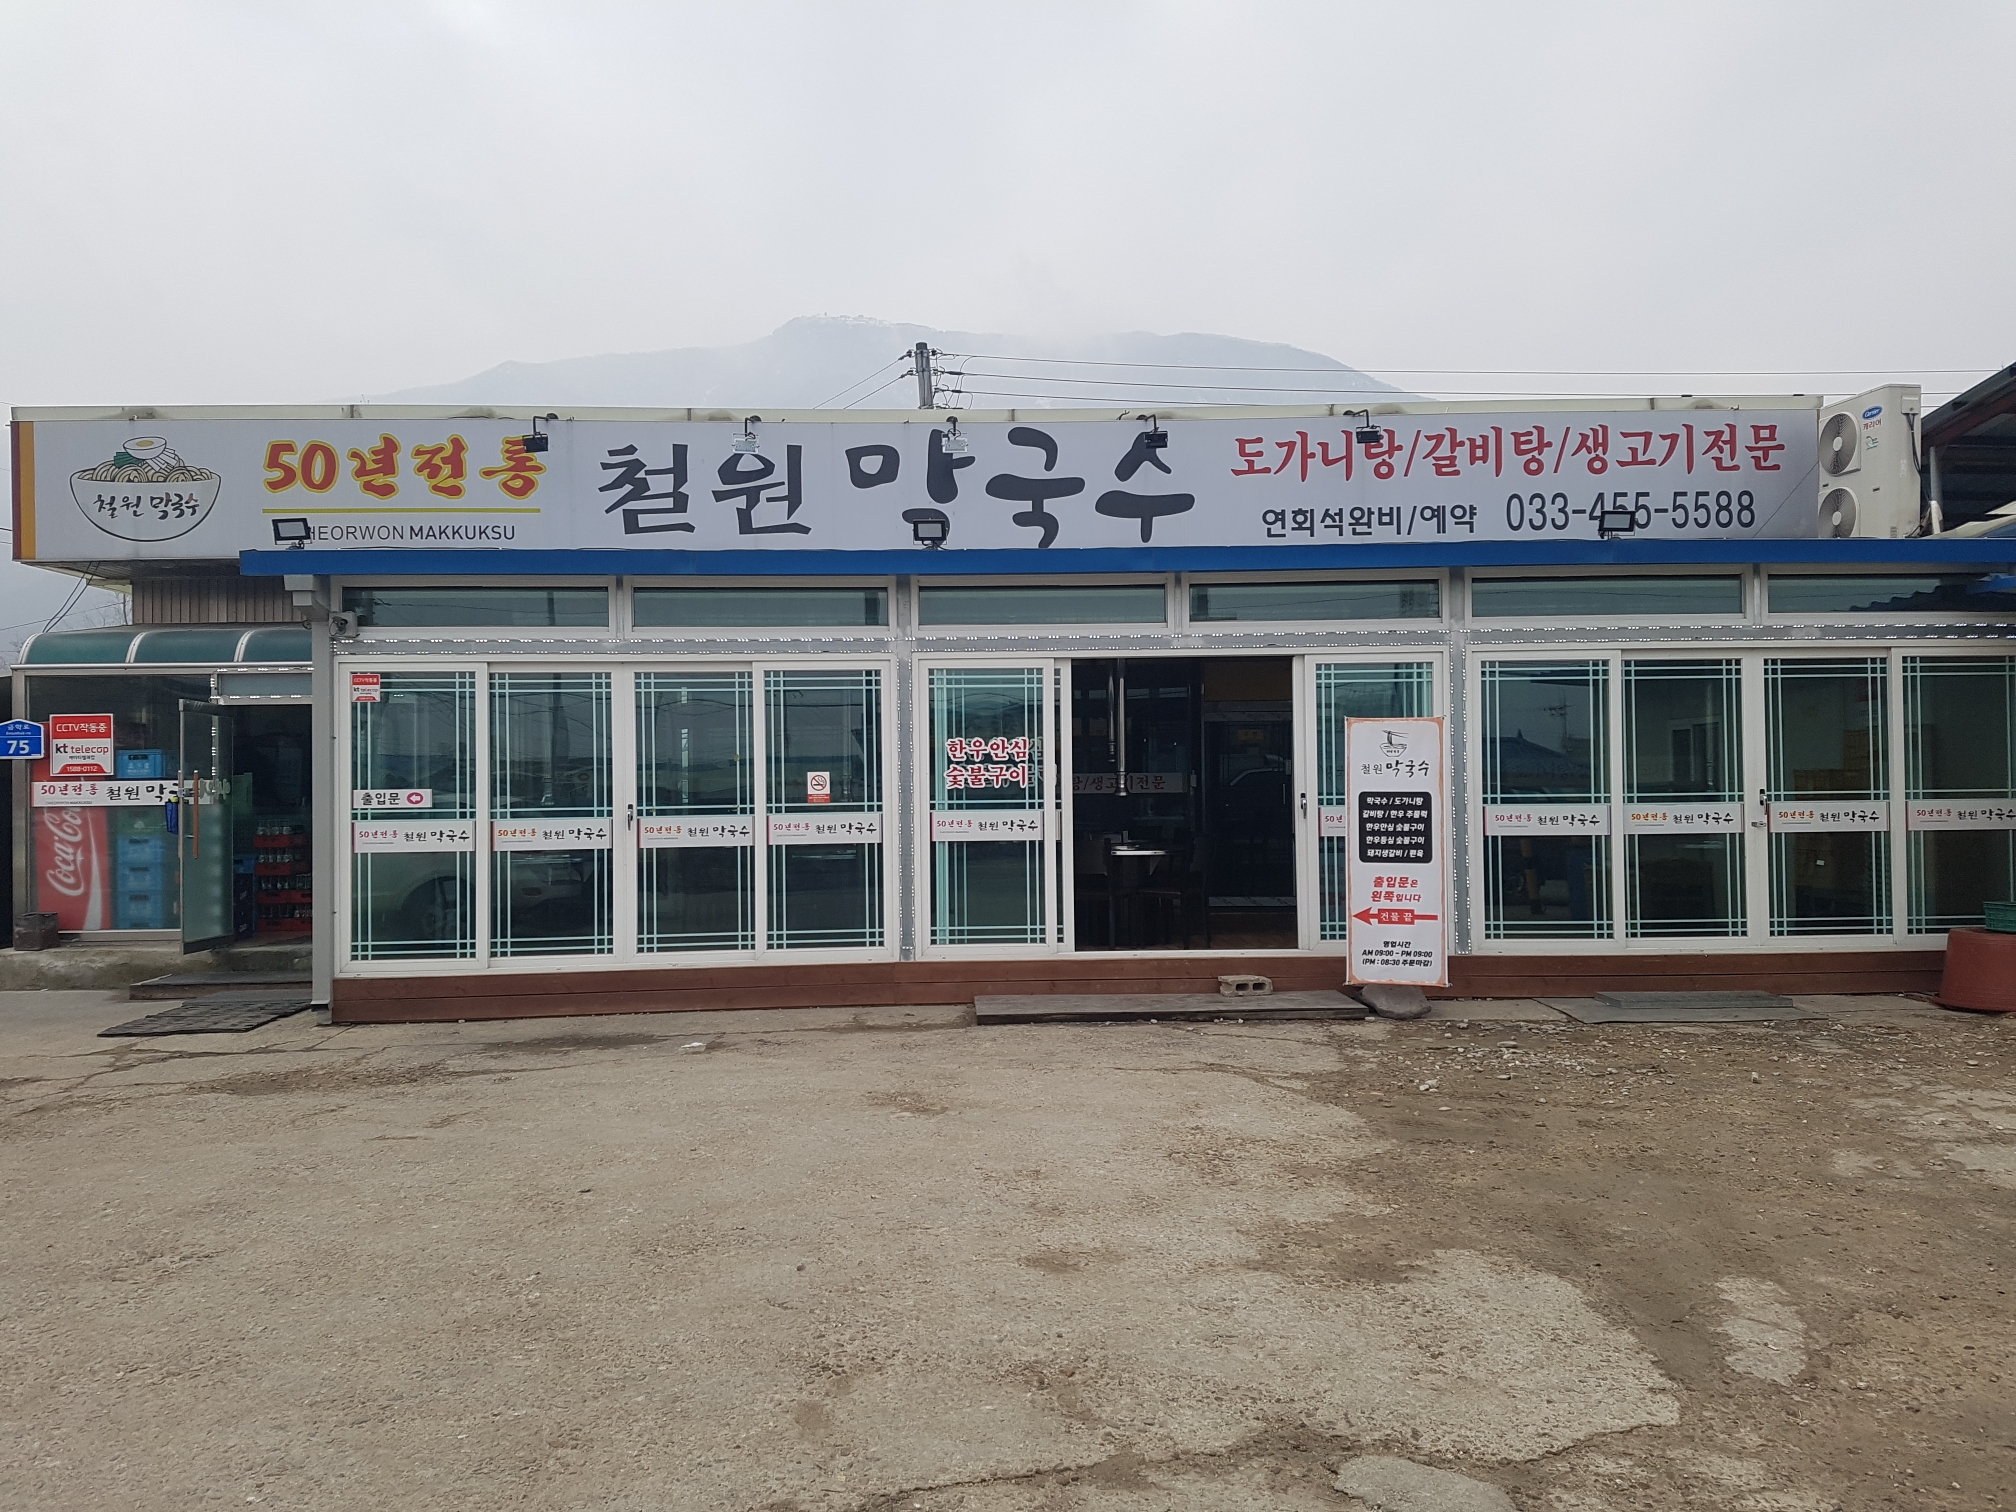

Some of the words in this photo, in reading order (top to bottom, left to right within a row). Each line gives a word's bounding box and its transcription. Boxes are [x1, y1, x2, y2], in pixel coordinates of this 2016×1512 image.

[598, 444, 812, 535] 철원
[846, 427, 1195, 549] 막국수
[93, 493, 145, 519] 철원
[150, 492, 200, 520] 막국수
[310, 525, 404, 541] EORWON
[410, 525, 516, 541] MAKKUKSU
[56, 722, 108, 733] CCTV작동중
[7, 740, 30, 755] 75
[55, 743, 69, 754] kt
[71, 744, 109, 756] telecop
[946, 738, 1029, 760] 한우안심
[1361, 763, 1383, 775] 철원
[1386, 759, 1429, 778] 막국수
[944, 764, 1028, 788] 숯불구이
[40, 783, 99, 795] 50년전통
[106, 785, 140, 801] 철원
[360, 792, 401, 806] 출입문
[1390, 810, 1404, 818] 한우
[1562, 813, 1600, 826] 막국수
[1697, 812, 1734, 825] 막국수
[1843, 810, 1880, 823] 막국수
[1980, 808, 2016, 821] 막국수
[712, 825, 750, 838] 막국수
[840, 822, 877, 835] 막국수
[1002, 819, 1038, 832] 막국수
[430, 829, 470, 843] 막국수
[568, 827, 607, 840] 막국수
[1373, 876, 1418, 888] 출입문은
[1371, 890, 1422, 902] 왼쪽입니다
[1380, 912, 1400, 922] 건물
[1403, 912, 1413, 922] 끝
[1362, 958, 1376, 966] (PM
